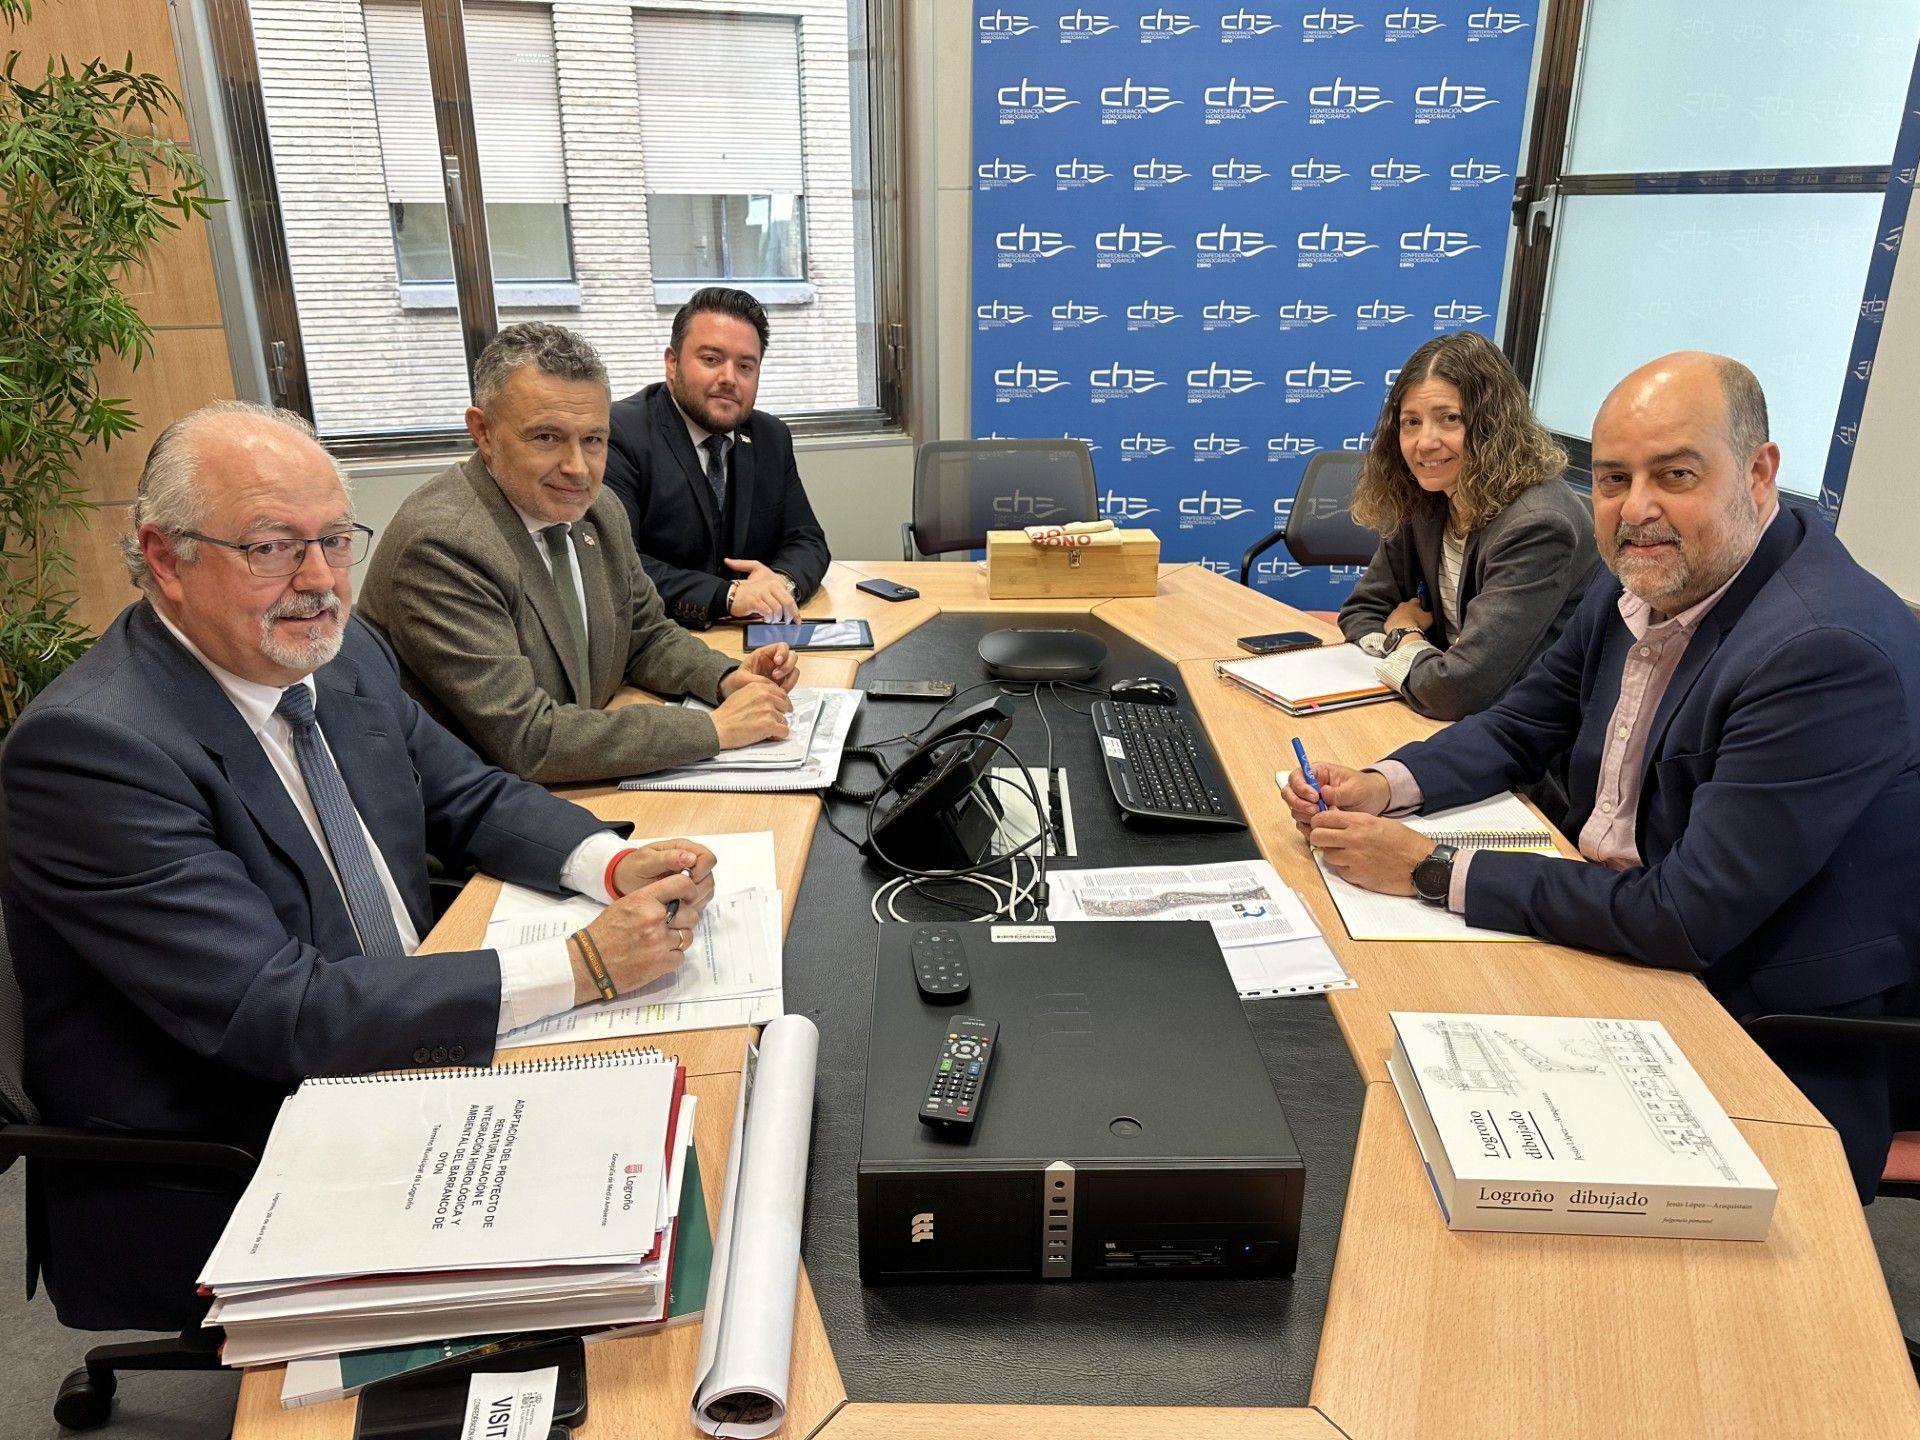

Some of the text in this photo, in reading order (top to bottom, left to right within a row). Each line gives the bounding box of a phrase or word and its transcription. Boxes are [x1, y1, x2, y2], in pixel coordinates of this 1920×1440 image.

[470, 1104, 494, 1156] INTEGRACIÓN
[1470, 1110, 1500, 1158] Logroño
[1508, 1110, 1542, 1160] dibujado
[432, 1104, 479, 1230] AMBIENTAL DEL BARRANCO DE
[433, 1152, 448, 1174] OYÓN
[474, 1118, 506, 1198] RENATURALIZACIÓN
[482, 1100, 525, 1228] ADAPTACIÓN DEL PROYECTO DE
[452, 1158, 478, 1217] HIDROLÓGICA
[622, 1176, 636, 1210] Logroño
[1479, 1186, 1648, 1209] Logroño dibujado
